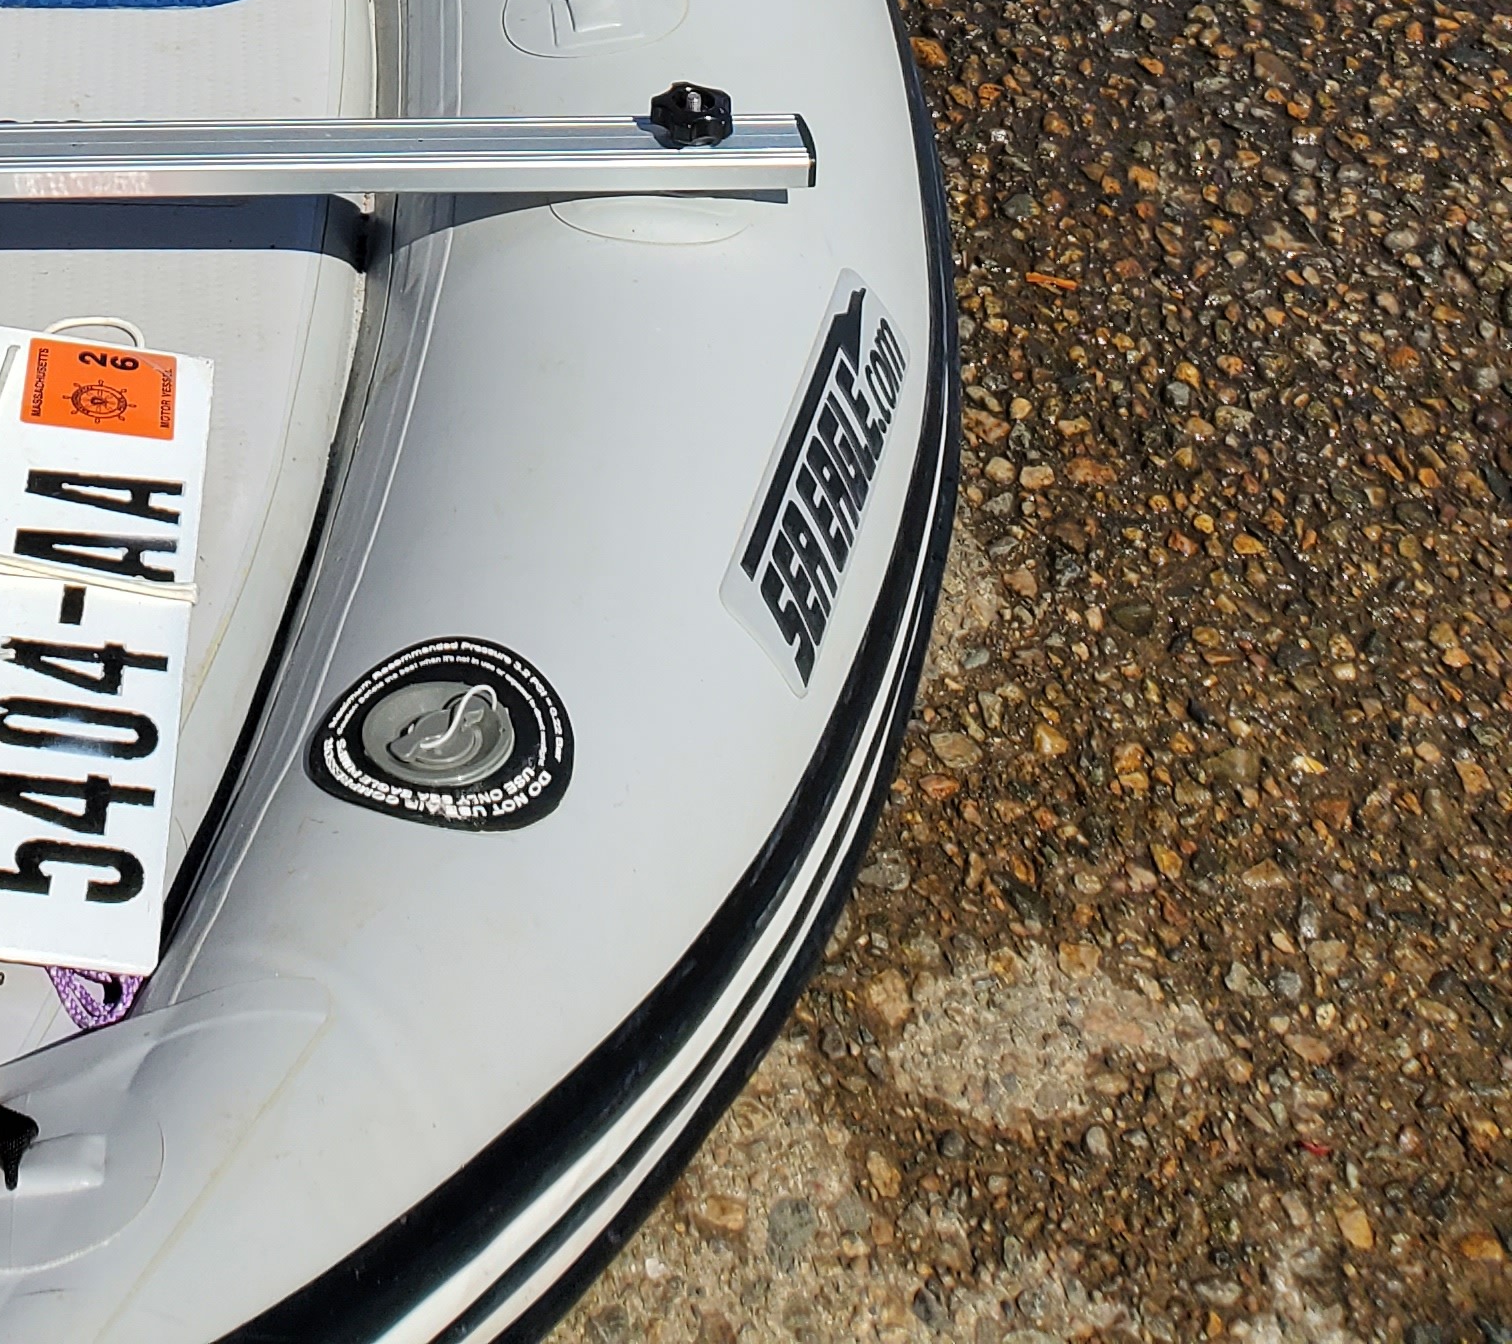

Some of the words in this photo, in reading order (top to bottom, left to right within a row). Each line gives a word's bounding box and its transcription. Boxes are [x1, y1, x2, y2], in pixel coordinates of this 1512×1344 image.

[31, 348, 49, 417] MASSACHUSETTS
[160, 399, 172, 428] MOTOR
[419, 656, 442, 667] when
[456, 655, 470, 663] not
[470, 656, 480, 665] in
[480, 660, 496, 672] use
[328, 680, 372, 729] Maximum
[372, 641, 458, 681] Recommended
[461, 641, 512, 665] Pressure
[513, 661, 531, 678] 3.2
[529, 676, 548, 697] PSI
[323, 737, 400, 805] COMPRESSOR
[503, 766, 536, 795] USE
[528, 770, 552, 797] DO
[359, 774, 413, 799] EAGLE
[417, 791, 454, 804] SEA
[456, 788, 504, 807] ONLY
[404, 797, 442, 815] AIR
[445, 804, 488, 819] USE
[492, 792, 529, 816] NOT
